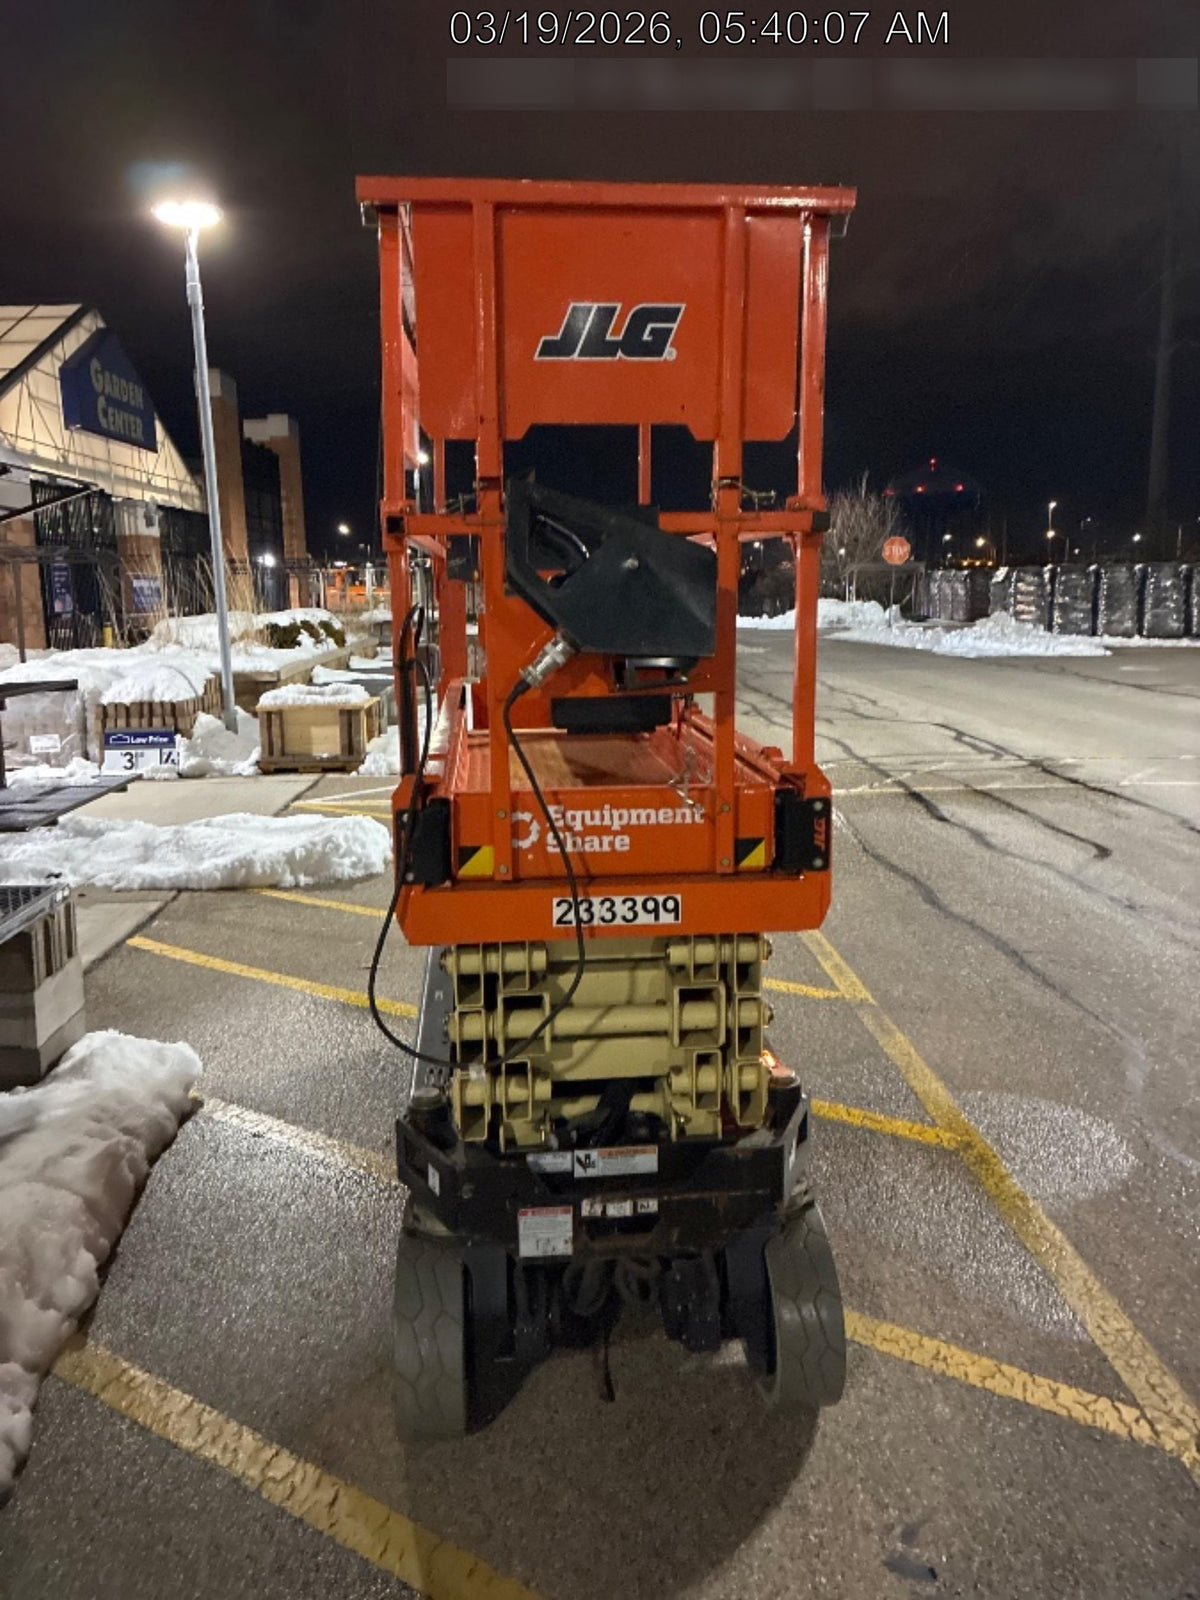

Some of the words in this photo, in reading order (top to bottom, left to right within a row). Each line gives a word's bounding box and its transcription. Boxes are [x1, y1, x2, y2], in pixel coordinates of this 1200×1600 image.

[533, 302, 686, 360] JLG
[546, 803, 705, 832] Equipment
[546, 831, 630, 853] Share
[555, 895, 680, 926] 233399
